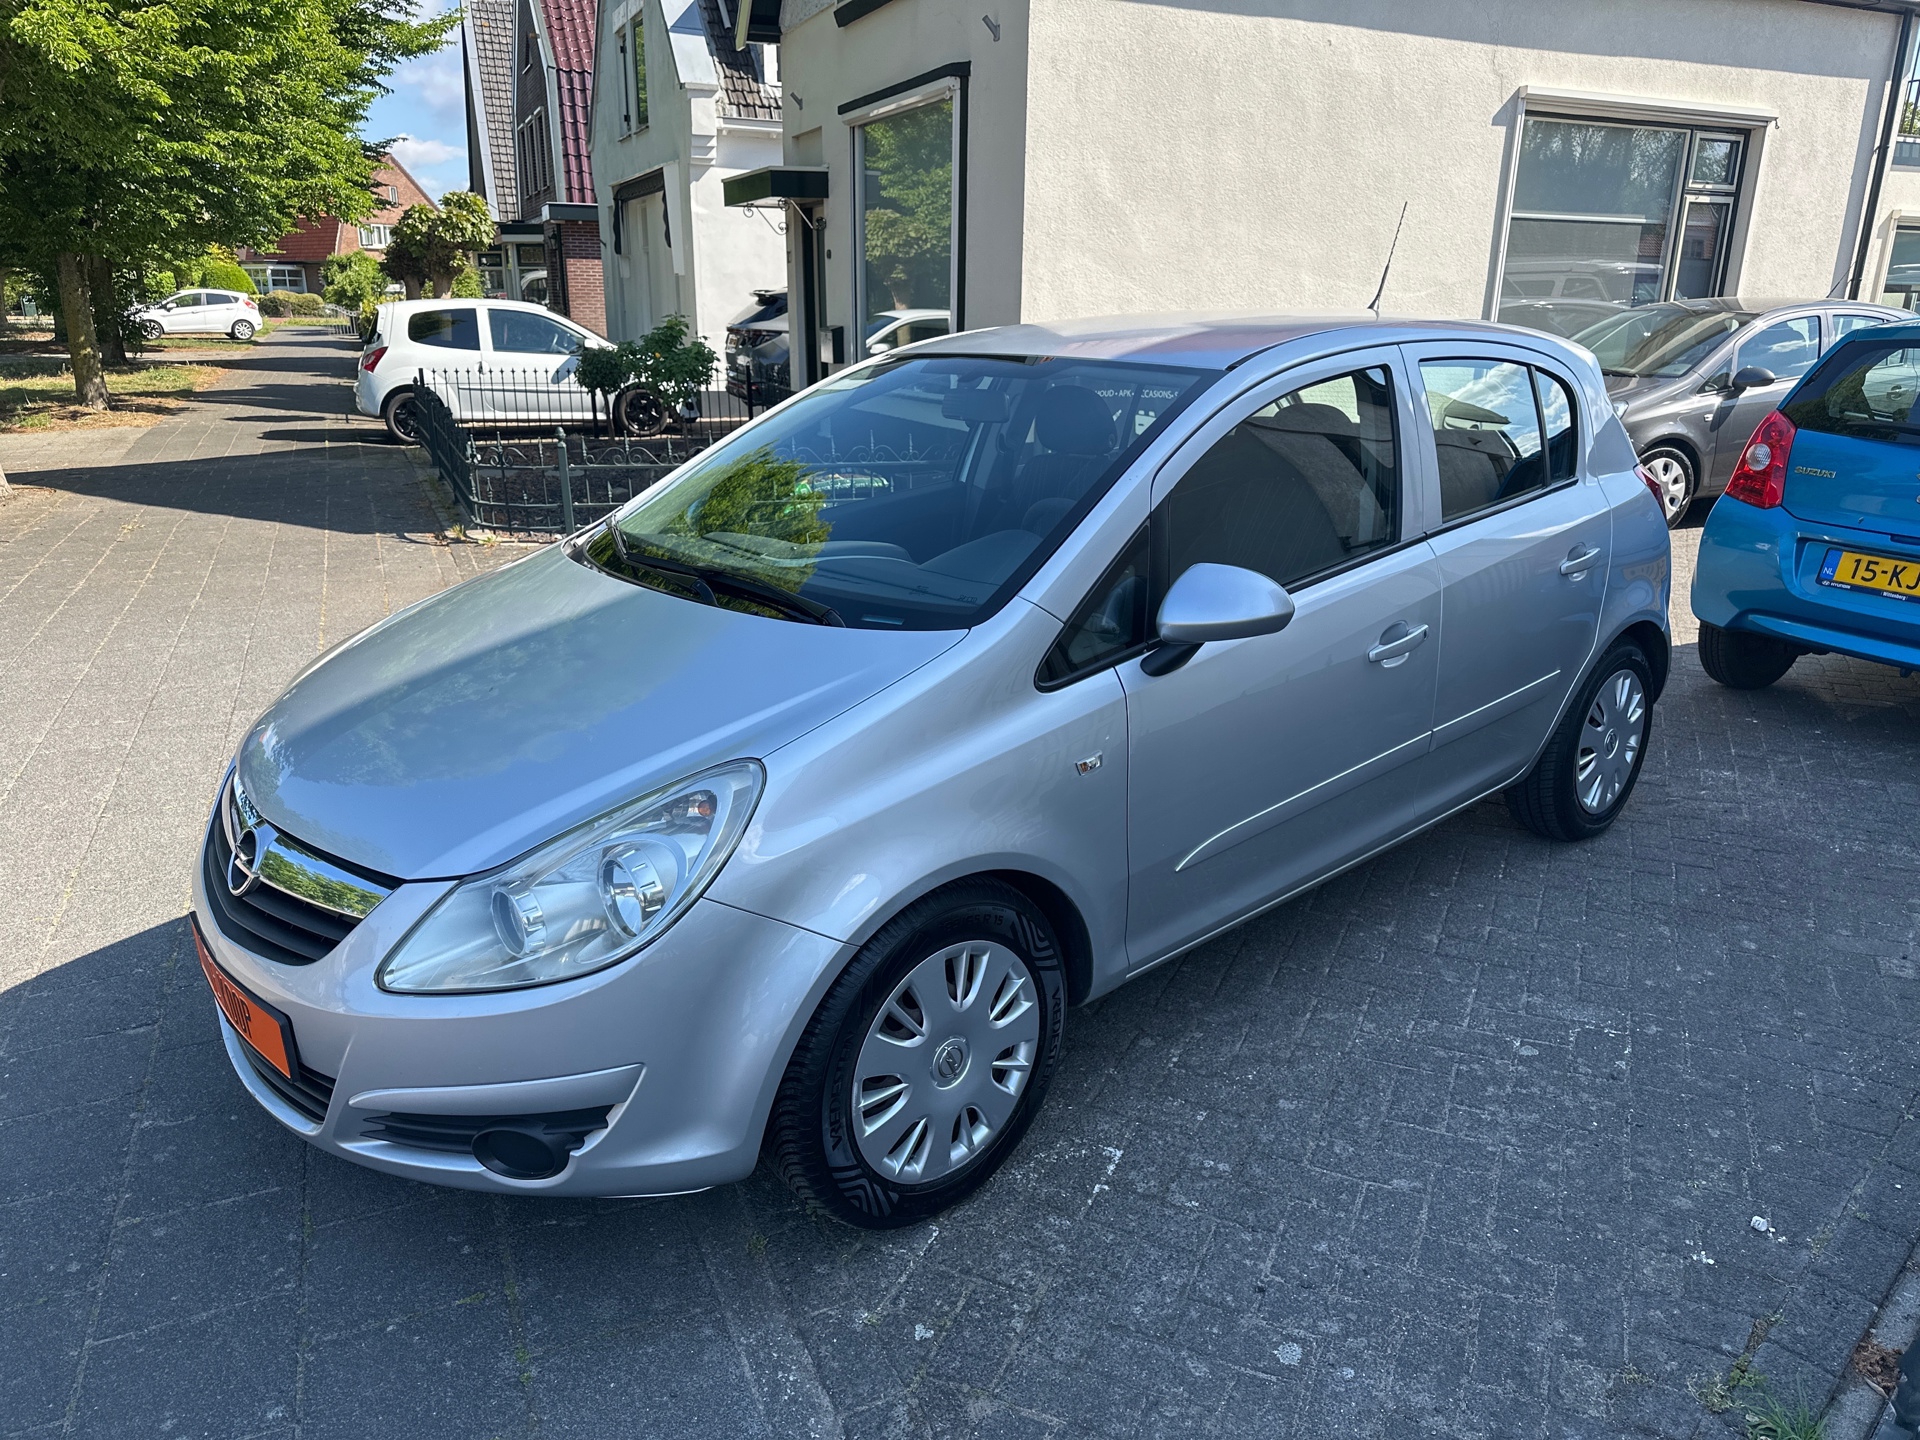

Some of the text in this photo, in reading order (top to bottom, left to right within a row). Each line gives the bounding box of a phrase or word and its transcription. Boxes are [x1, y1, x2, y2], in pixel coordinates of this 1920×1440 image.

[1118, 389, 1132, 398] APK
[1794, 465, 1837, 479] SUZUKI
[1822, 566, 1835, 576] NL
[1038, 985, 1062, 1090] VREDESTEIN
